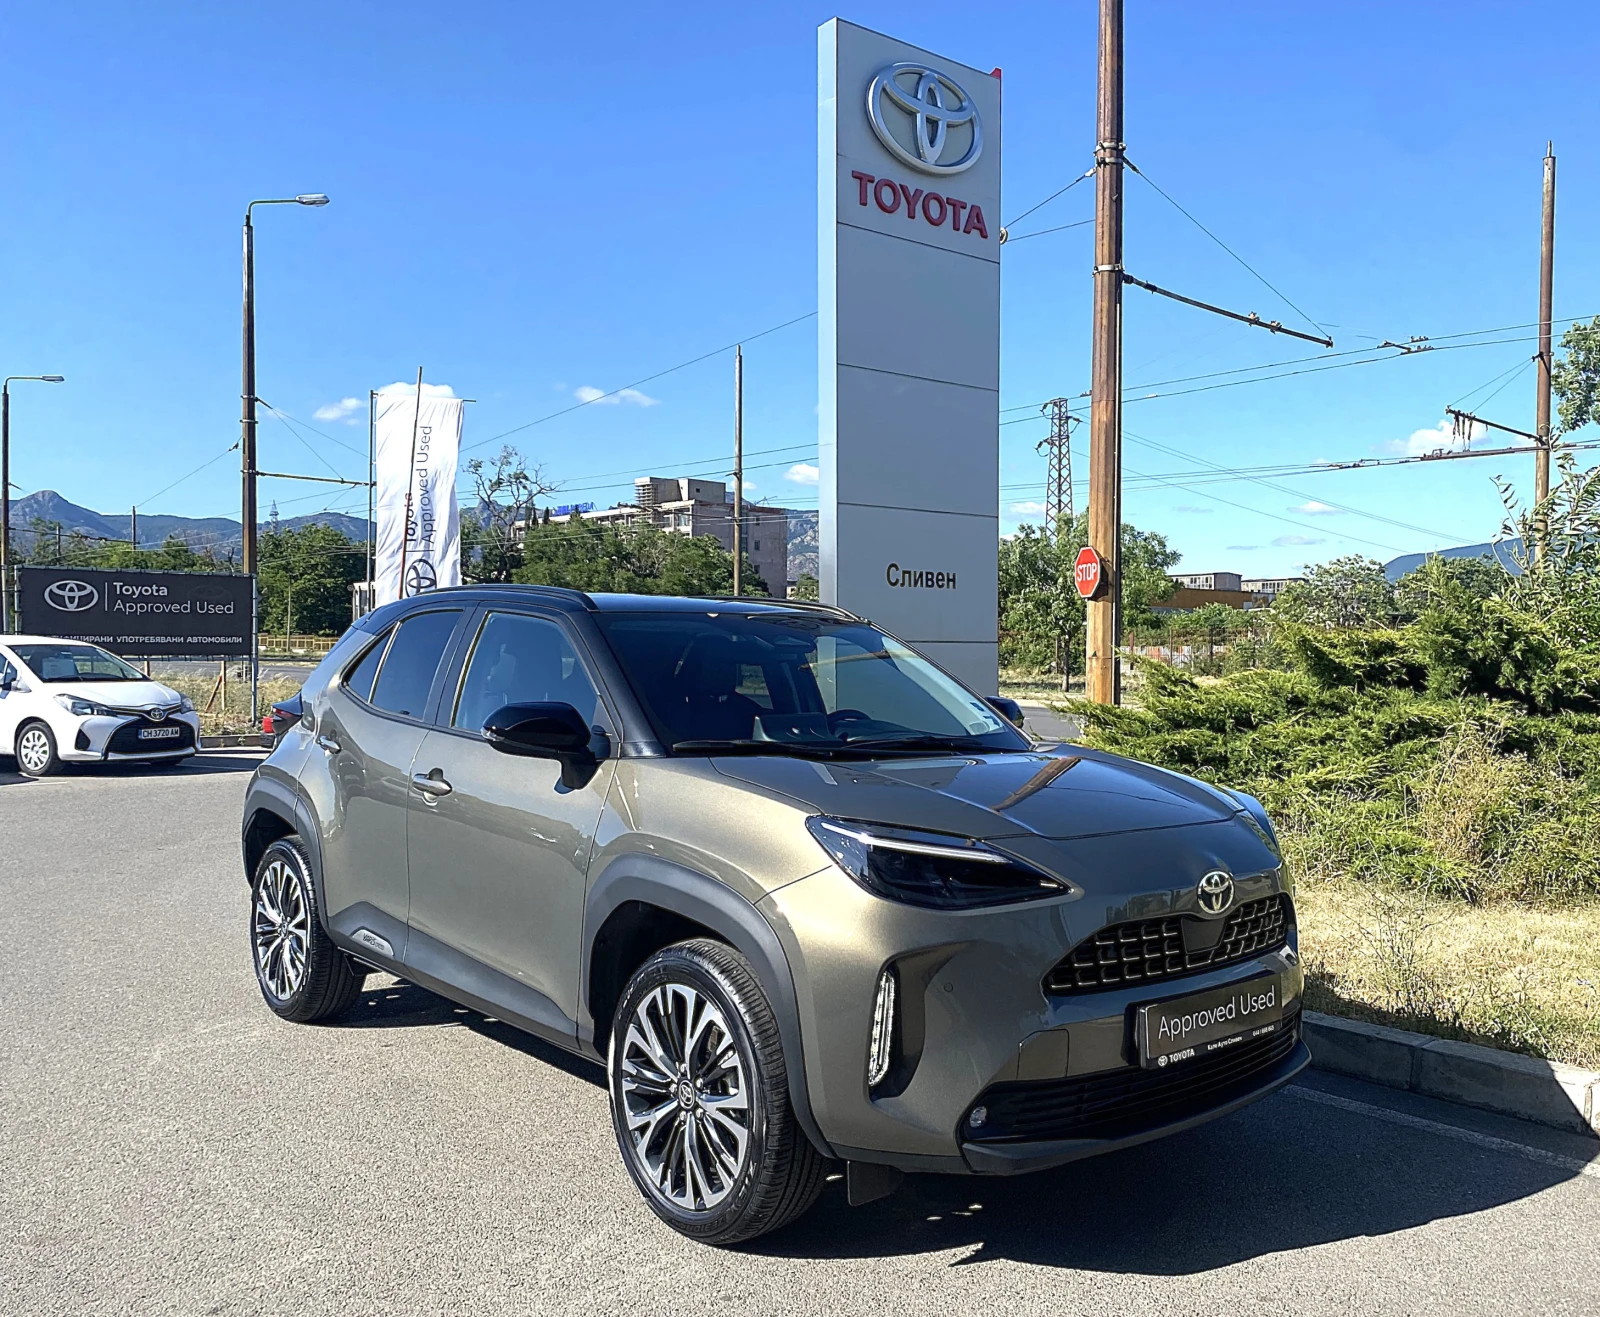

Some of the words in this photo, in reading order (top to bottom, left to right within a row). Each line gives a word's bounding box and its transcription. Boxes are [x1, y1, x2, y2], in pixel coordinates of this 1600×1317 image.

[851, 169, 988, 239] TOYOTA
[416, 425, 432, 463] Used
[415, 468, 436, 544] Approved
[886, 562, 957, 589] Сливен
[1076, 564, 1098, 583] STOP
[113, 581, 168, 598] Toyota
[113, 600, 191, 615] Approved
[196, 600, 234, 614] Used
[116, 635, 184, 643] УПОТРЕБЯВАНИ
[186, 635, 243, 644] АВТОМОБИЛИ
[1158, 996, 1236, 1042] Approved
[1240, 984, 1275, 1015] Used
[1168, 1048, 1195, 1063] TOYOTA
